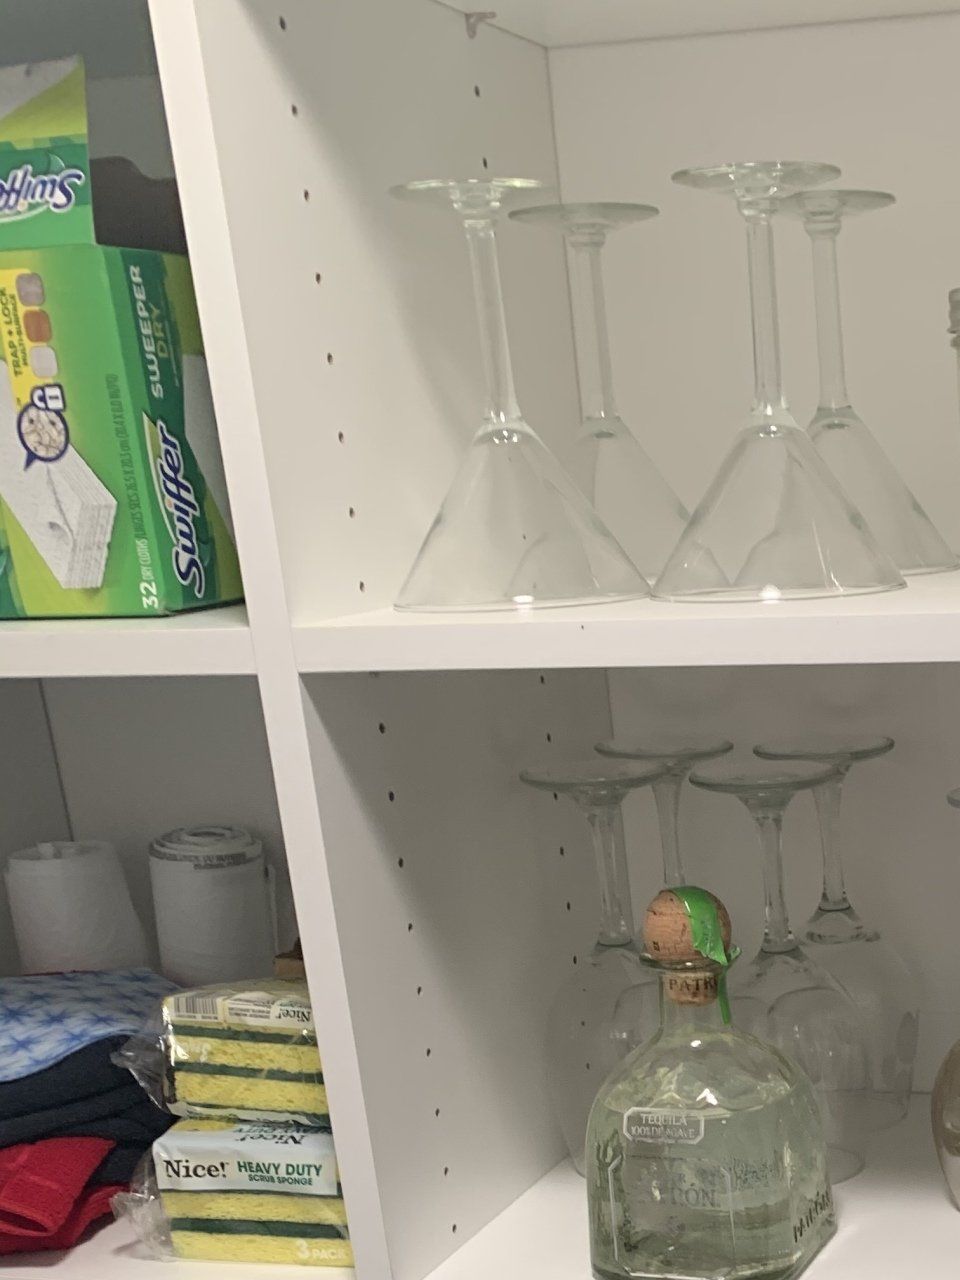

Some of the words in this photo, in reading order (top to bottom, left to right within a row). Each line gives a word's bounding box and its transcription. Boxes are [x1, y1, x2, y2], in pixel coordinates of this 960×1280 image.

[0, 165, 85, 212] Swiff
[130, 265, 163, 399] SWEEPER
[150, 302, 169, 358] DRY
[9, 340, 22, 376] TRAP
[157, 419, 205, 598] Swiffer
[140, 581, 159, 609] 32
[641, 1113, 688, 1127] TEQUILA
[163, 1159, 227, 1179] Nice!
[237, 1160, 282, 1175] HEAVY
[285, 1163, 323, 1177] DUTY
[248, 1174, 276, 1184] SCRUB
[277, 1176, 313, 1186] SPONGE
